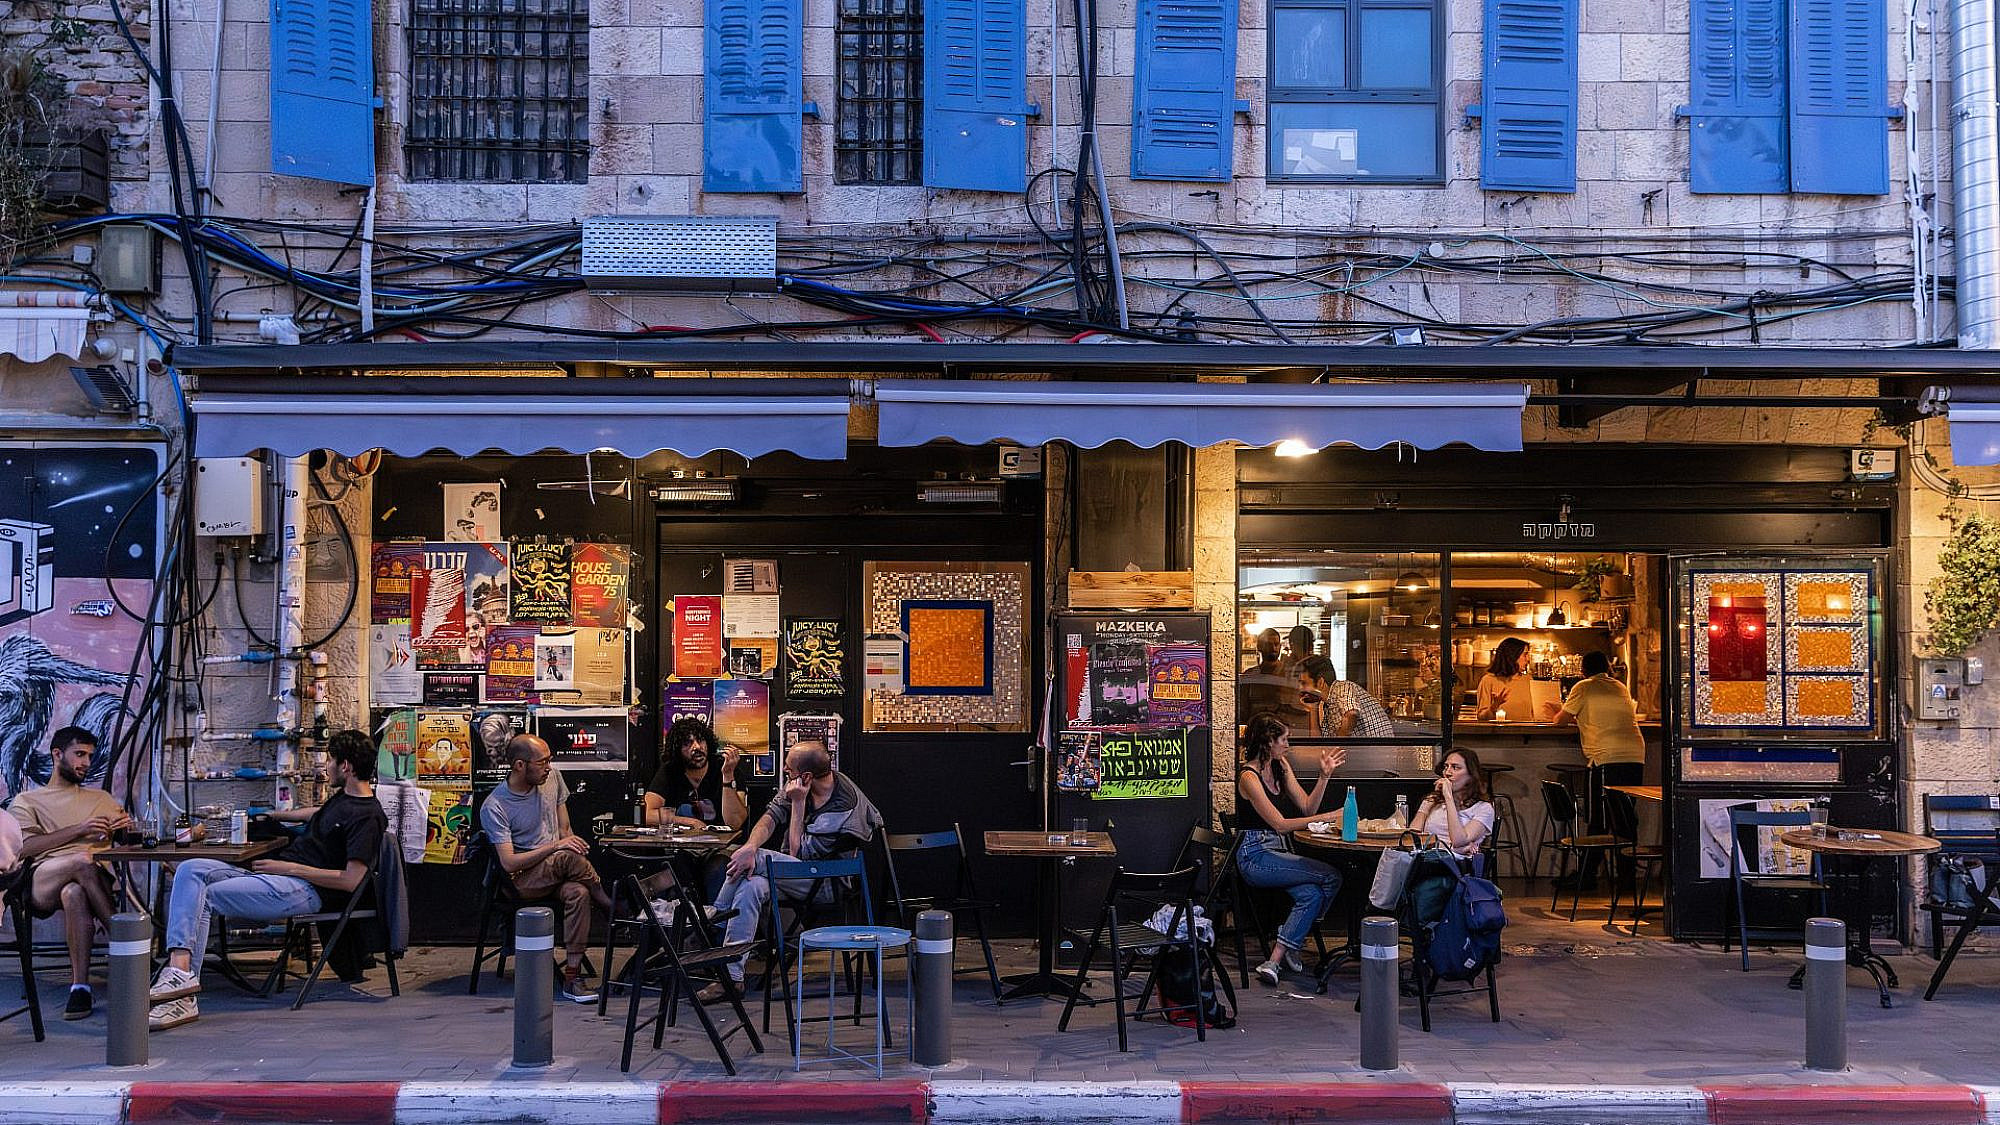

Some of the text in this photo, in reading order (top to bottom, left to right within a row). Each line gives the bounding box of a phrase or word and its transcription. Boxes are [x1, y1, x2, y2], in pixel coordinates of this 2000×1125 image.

[1523, 524, 1595, 539] מזקקה
[517, 544, 540, 560] JUICY
[542, 544, 565, 558] LUCY
[425, 552, 468, 569] קדרון
[571, 562, 612, 573] HOUSE
[576, 574, 626, 585] GARDEN
[602, 586, 617, 596] 75
[792, 622, 838, 639] JUICY LUCY
[1096, 621, 1166, 632] MAZKEKA
[568, 734, 596, 744] פינוי
[1135, 732, 1181, 756] אמנואל
